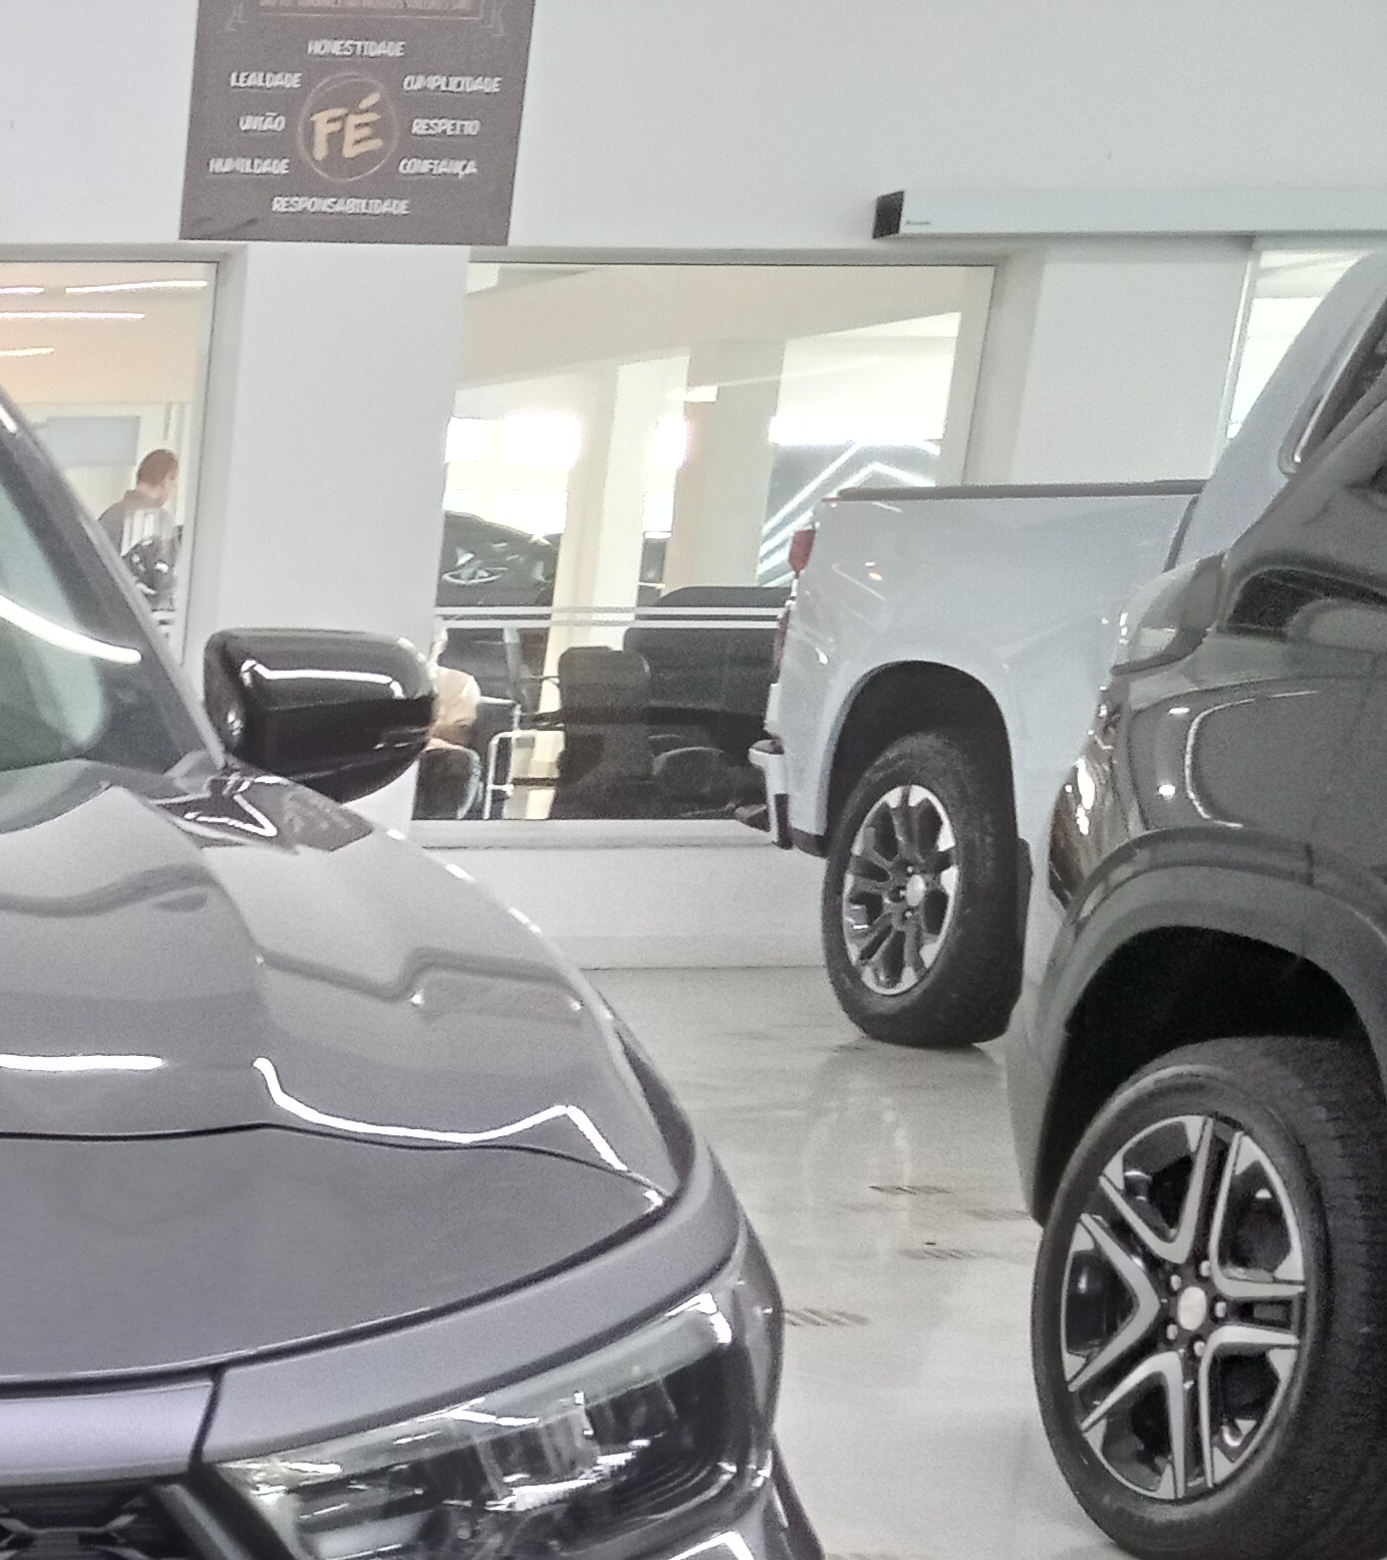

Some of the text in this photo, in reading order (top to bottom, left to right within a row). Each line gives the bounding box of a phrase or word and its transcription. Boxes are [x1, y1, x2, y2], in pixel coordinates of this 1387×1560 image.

[307, 40, 405, 57] HONESTIDADE
[230, 72, 302, 88] LEALDADE
[403, 75, 502, 93] CUMPLICIDADE
[239, 112, 286, 131] UNIÃO
[310, 92, 384, 161] FÉ
[411, 119, 481, 136] RESPEITO
[209, 158, 290, 174] HUMILDADE
[398, 158, 477, 178] CONFIANÇA
[272, 196, 410, 215] RESPONSABILIDADE
